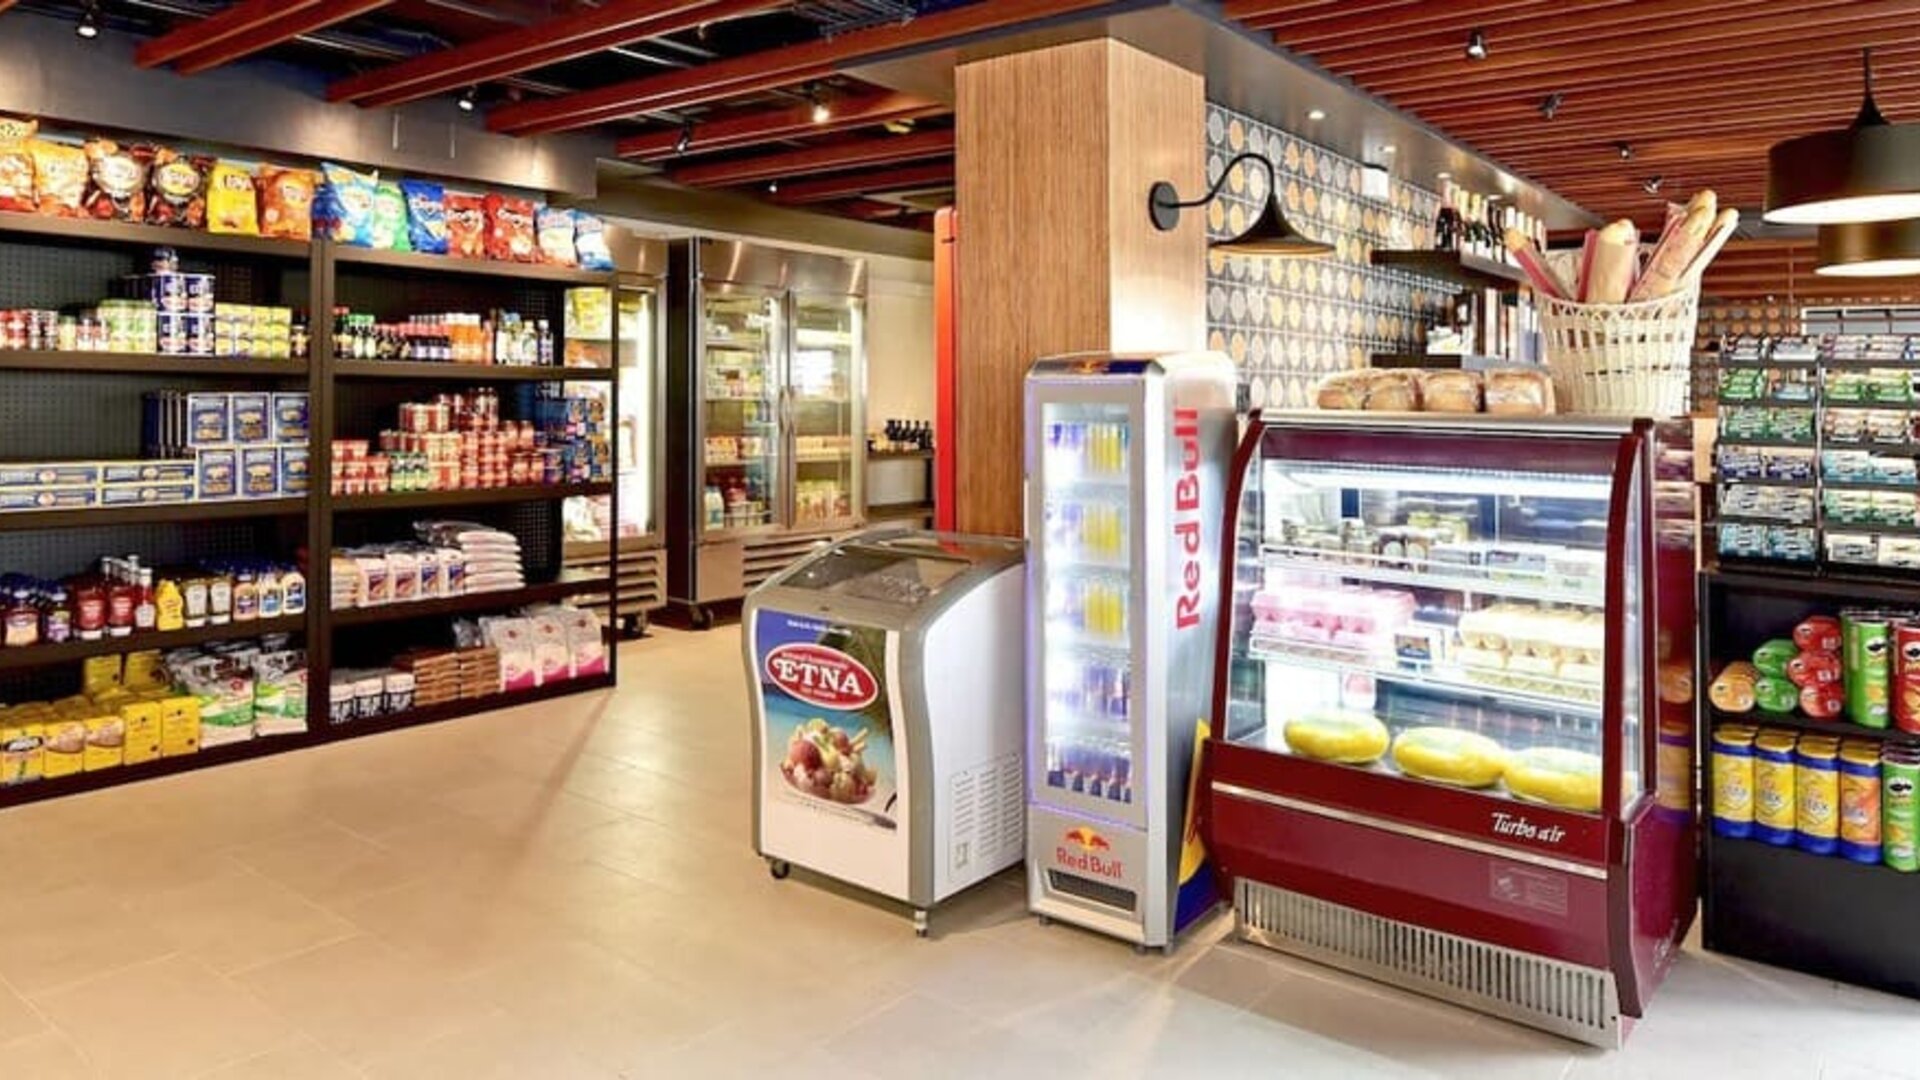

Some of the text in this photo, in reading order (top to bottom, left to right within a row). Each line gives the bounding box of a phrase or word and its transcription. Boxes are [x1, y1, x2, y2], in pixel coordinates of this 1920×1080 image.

[1174, 408, 1200, 629] Red Bull
[772, 658, 864, 697] ETNA
[1491, 812, 1566, 843] Turbo air
[1056, 846, 1123, 879] Red Bull
